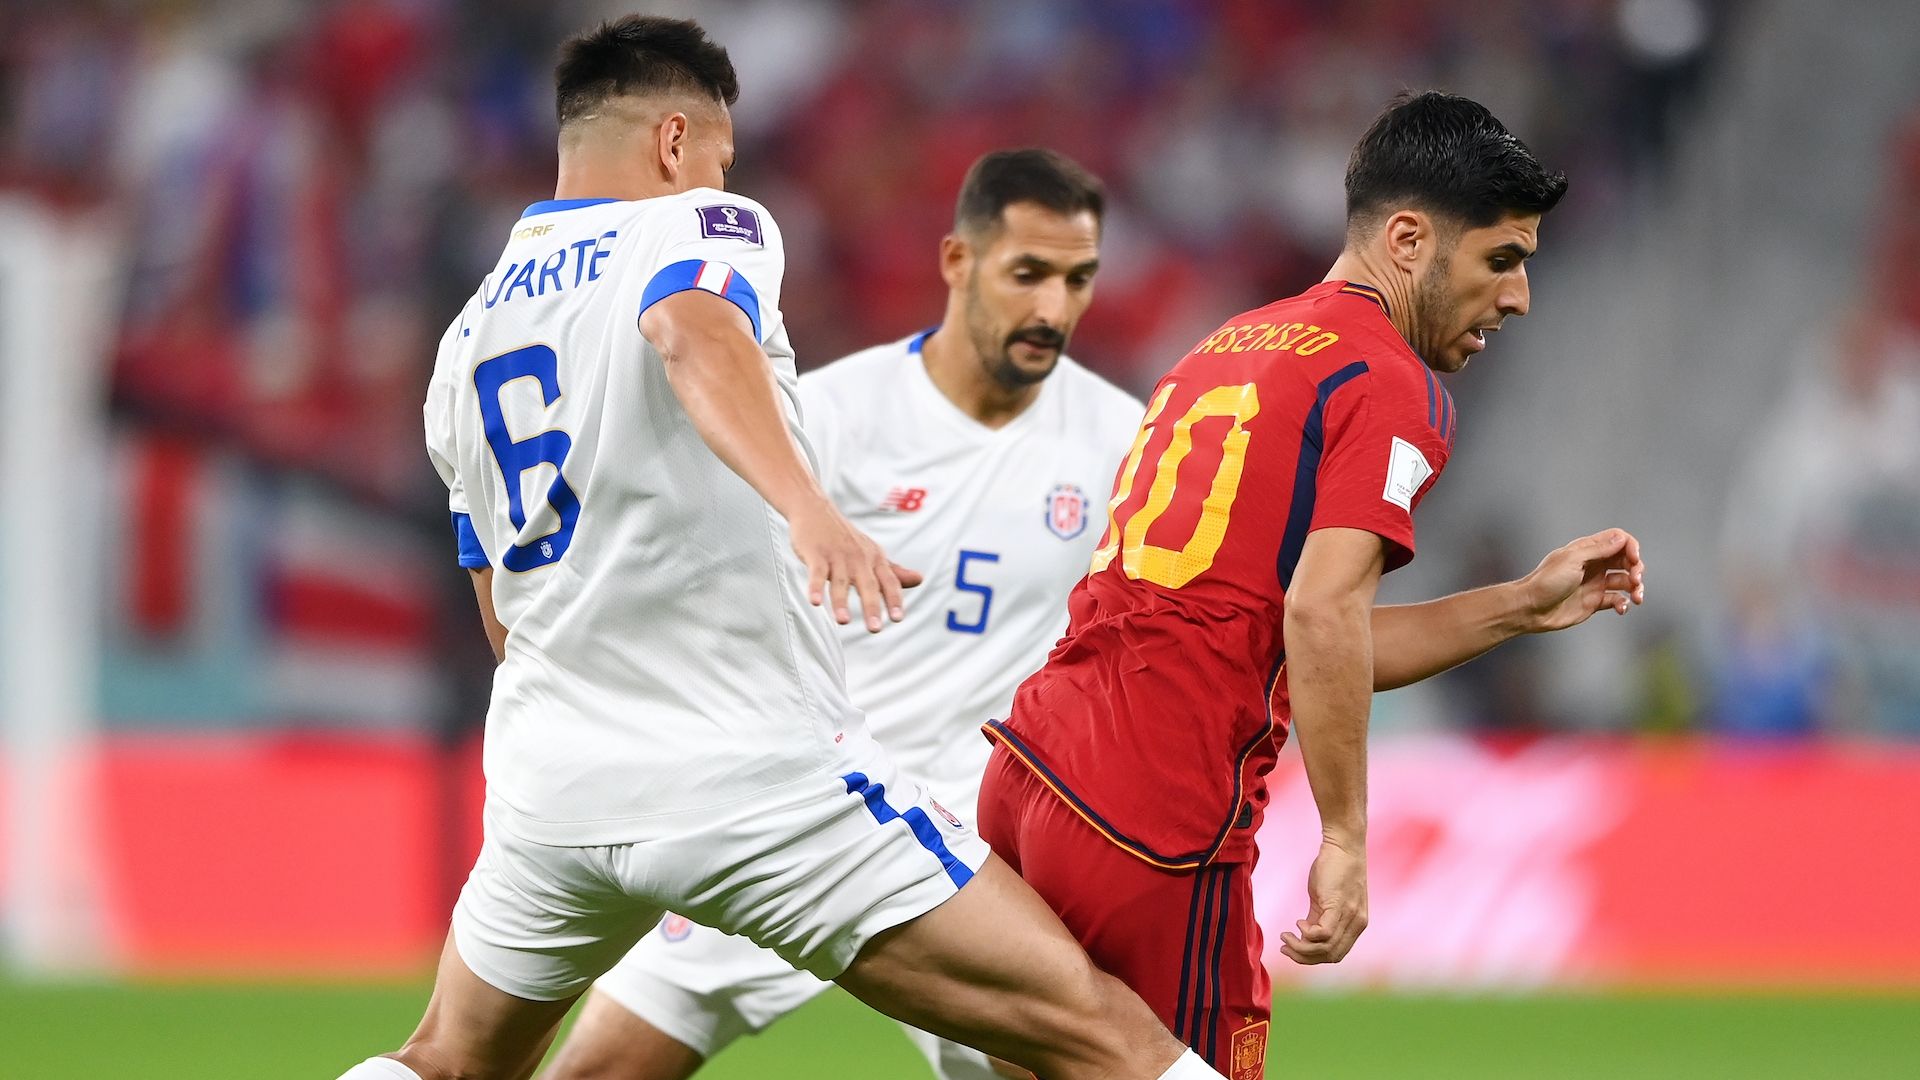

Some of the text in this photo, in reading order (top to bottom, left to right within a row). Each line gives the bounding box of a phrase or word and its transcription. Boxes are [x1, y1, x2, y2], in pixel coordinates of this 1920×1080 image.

[479, 230, 617, 313] UARTE
[1194, 323, 1339, 357] ASENSIO
[473, 342, 581, 573] 6
[1089, 382, 1260, 589] 10
[946, 549, 1000, 634] 5
